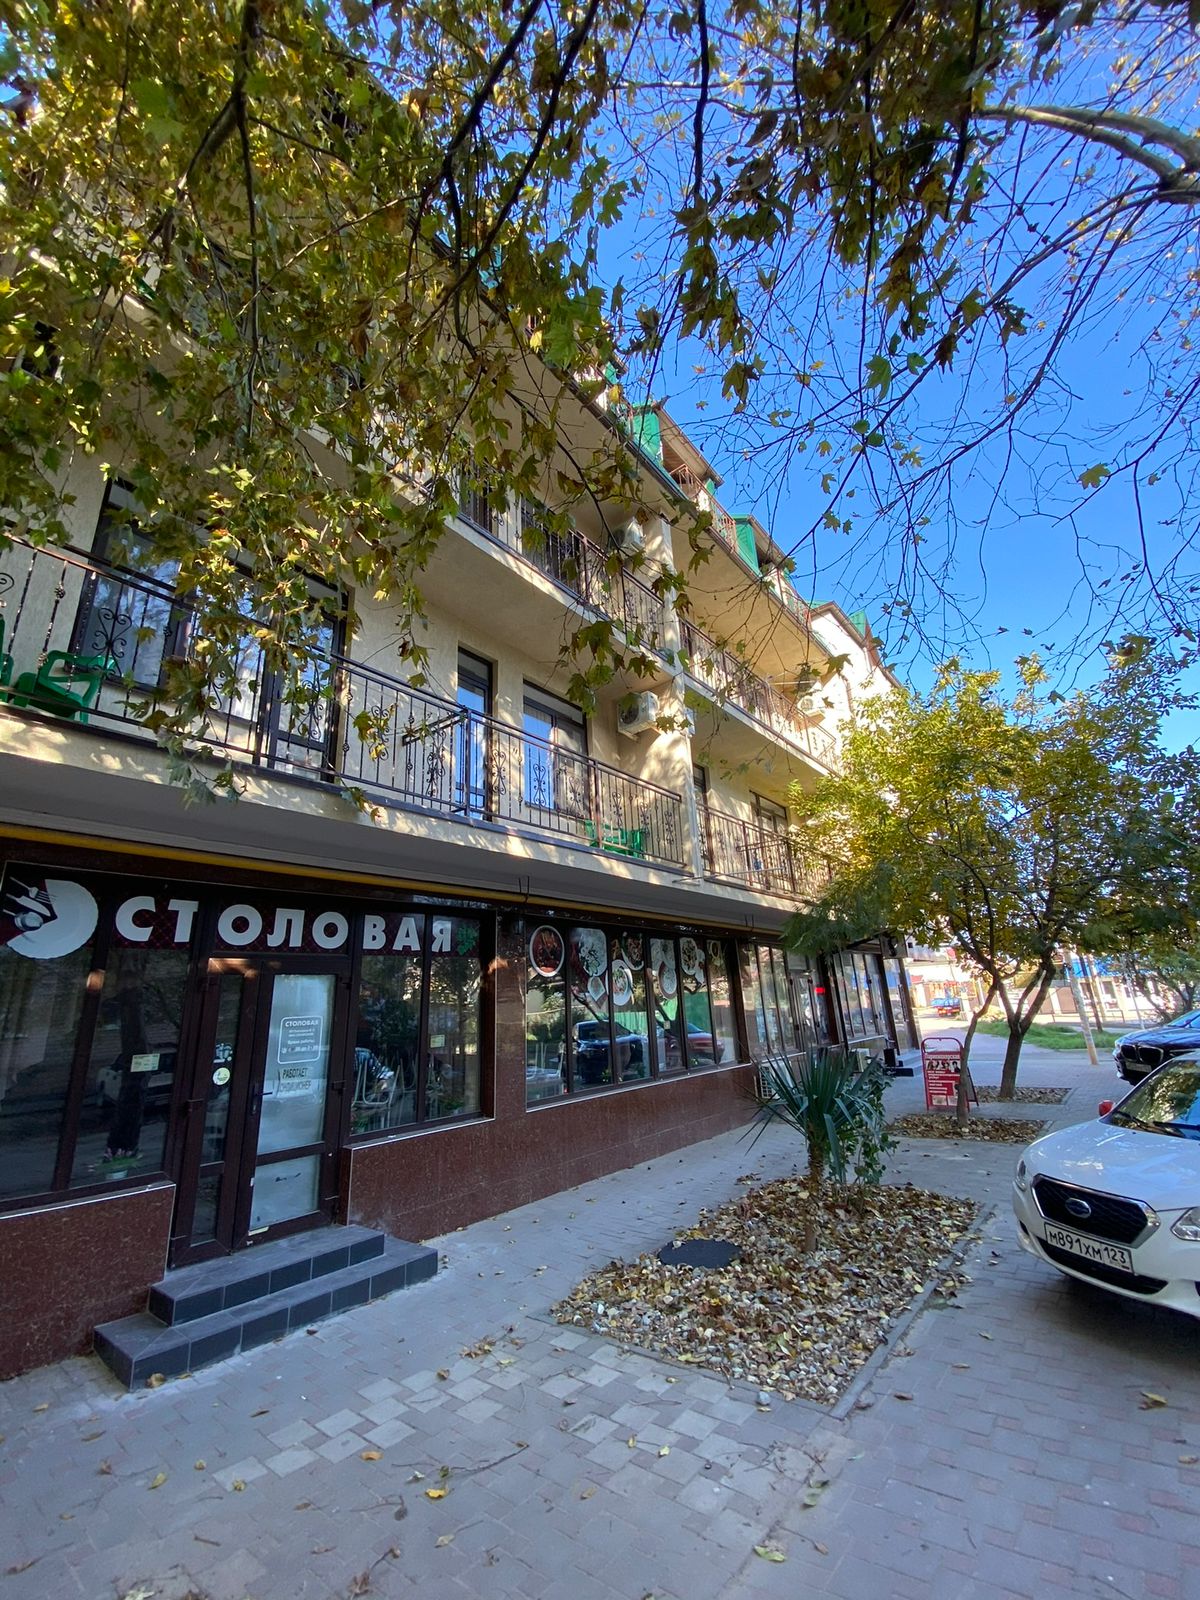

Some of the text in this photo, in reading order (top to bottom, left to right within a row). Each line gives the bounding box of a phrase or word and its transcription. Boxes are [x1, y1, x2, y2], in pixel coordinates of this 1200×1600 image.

[115, 896, 452, 953] СТОЛОВАЯ
[282, 1067, 309, 1079] РАБОТАЕТ
[1049, 1231, 1126, 1263] М891ХМ 123
